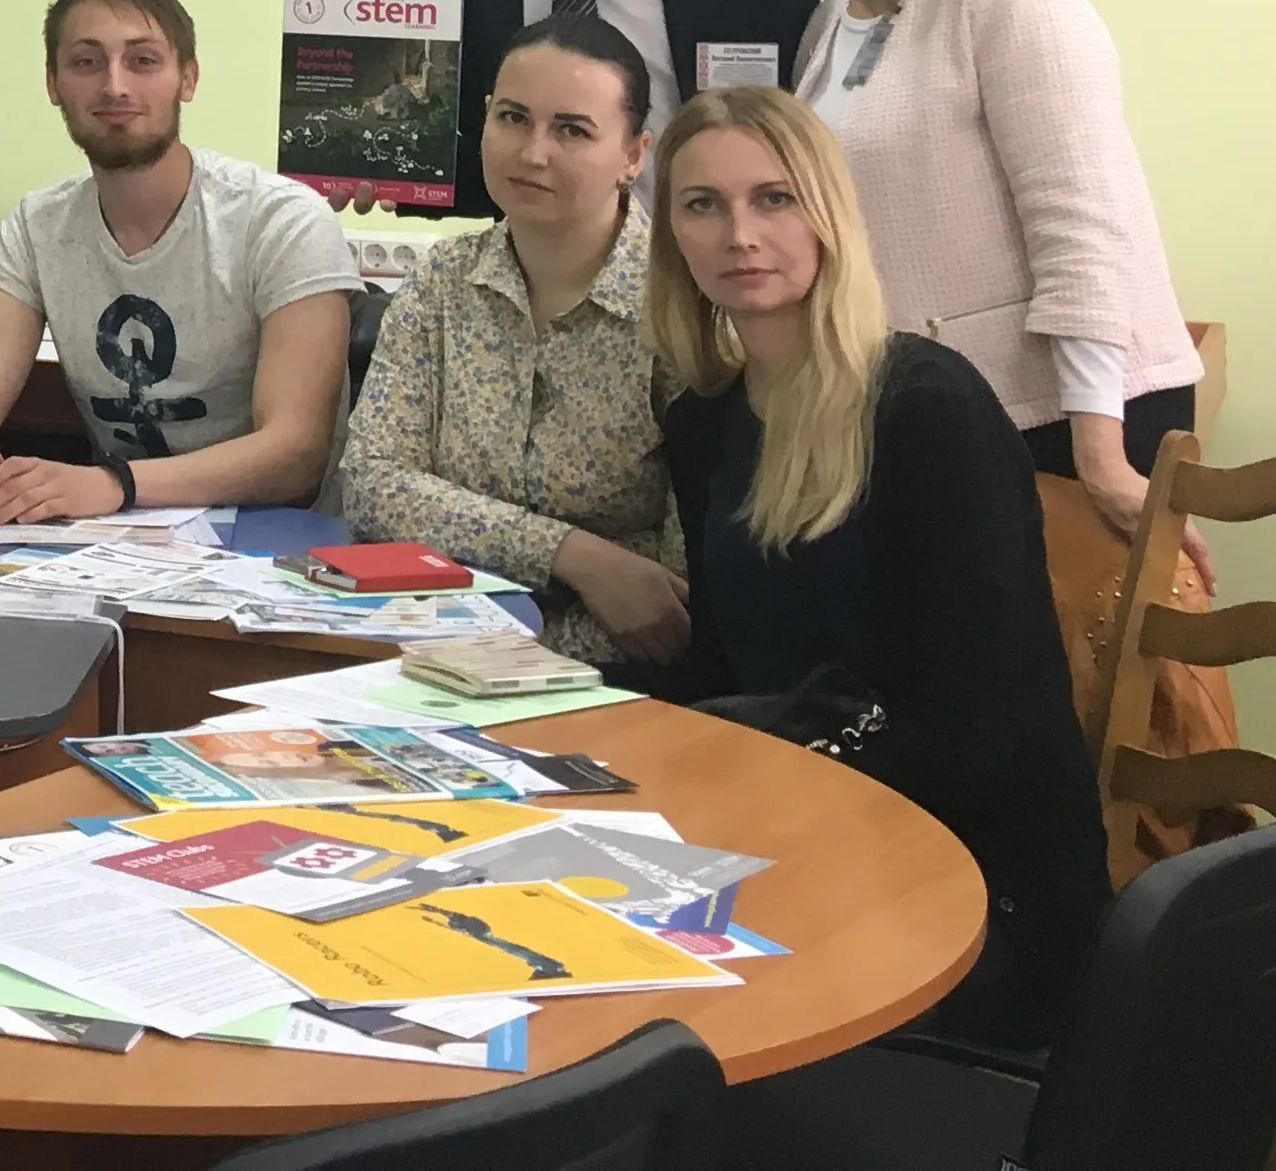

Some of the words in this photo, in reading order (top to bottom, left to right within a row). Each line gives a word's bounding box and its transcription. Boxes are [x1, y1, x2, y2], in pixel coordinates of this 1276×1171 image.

[297, 46, 335, 59] Beyond
[428, 190, 448, 200] STEM
[122, 854, 172, 869] STEM
[292, 932, 347, 961] Racers
[344, 962, 394, 987] Robo
